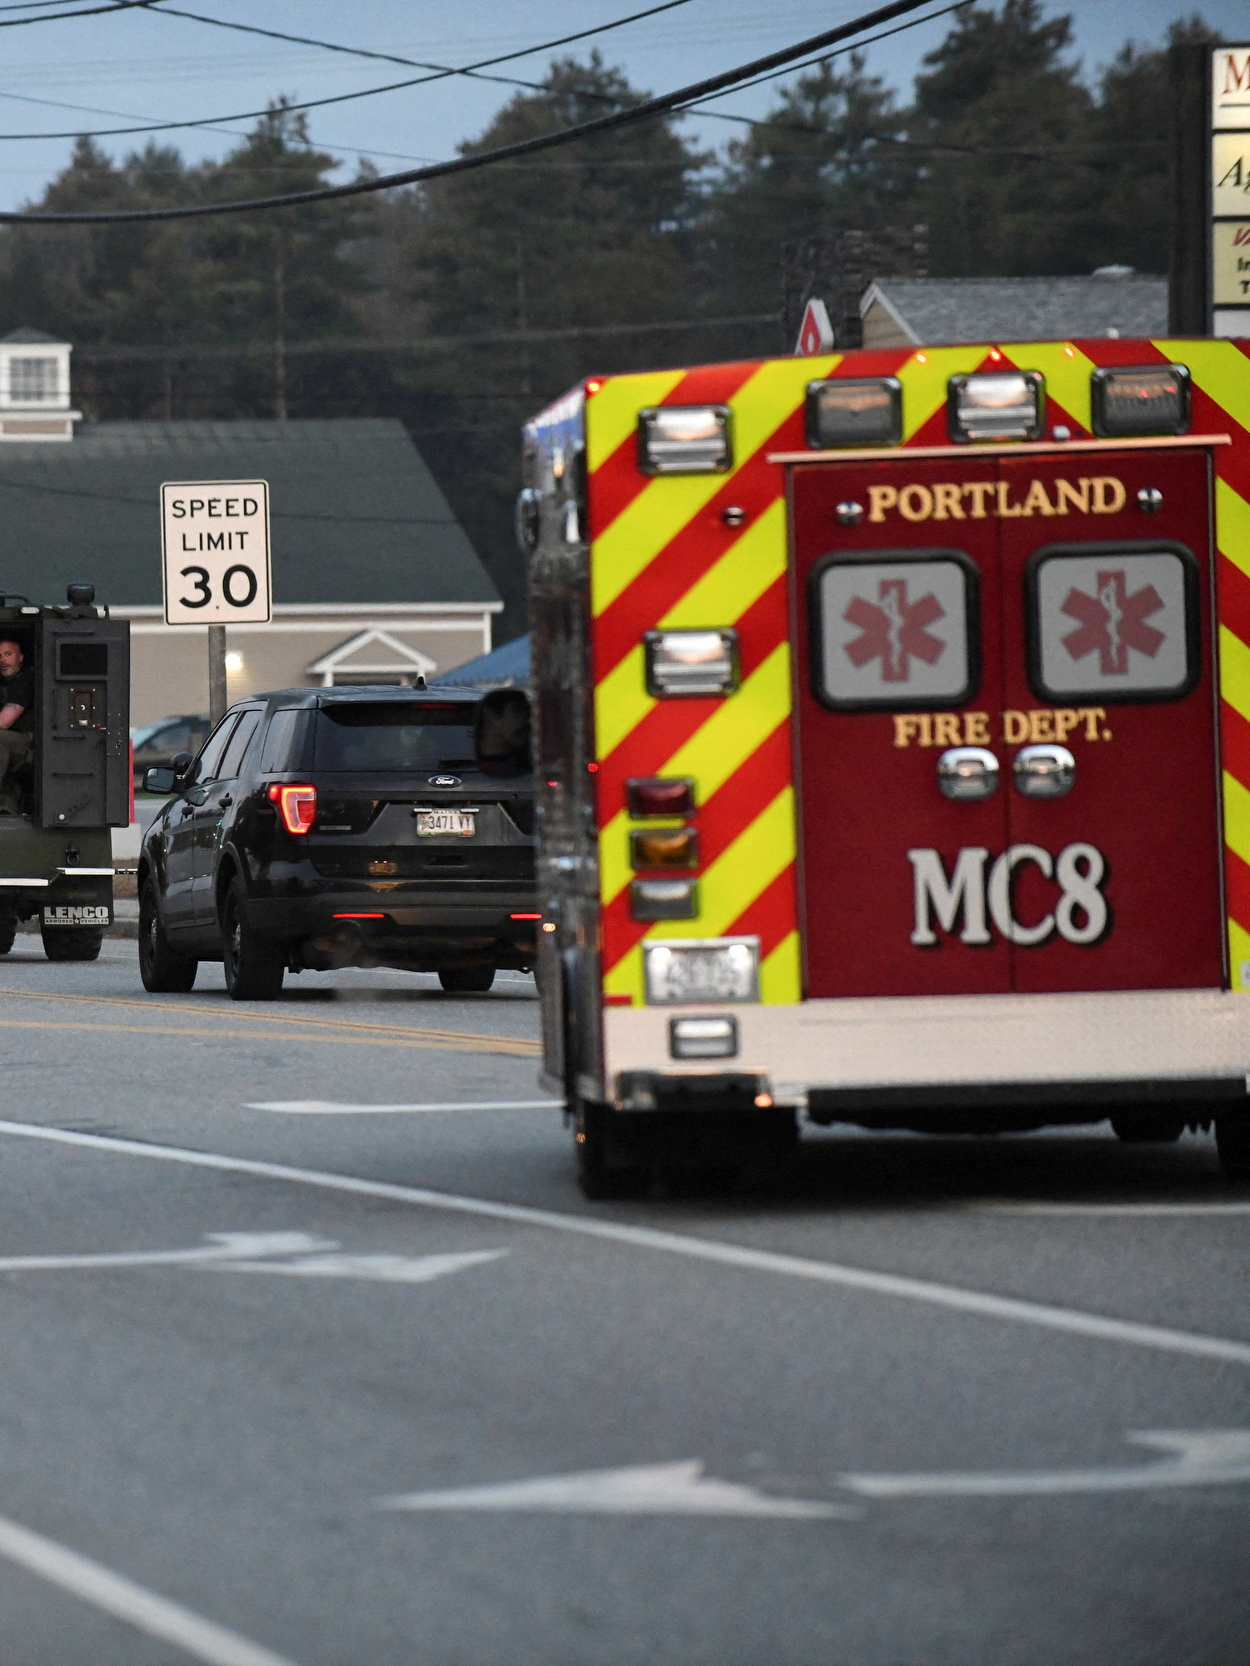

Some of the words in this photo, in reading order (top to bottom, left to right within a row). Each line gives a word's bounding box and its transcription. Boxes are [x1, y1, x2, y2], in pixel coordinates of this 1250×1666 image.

[172, 498, 258, 518] SPEED
[866, 476, 1127, 522] PORTLAND
[182, 532, 249, 551] LIMIT
[179, 564, 258, 609] 30
[893, 713, 991, 747] FIRE
[1003, 708, 1113, 743] DEPT.
[435, 776, 455, 785] Ford
[428, 816, 454, 830] 3471
[907, 842, 1108, 946] MC8
[44, 906, 109, 918] LENCO
